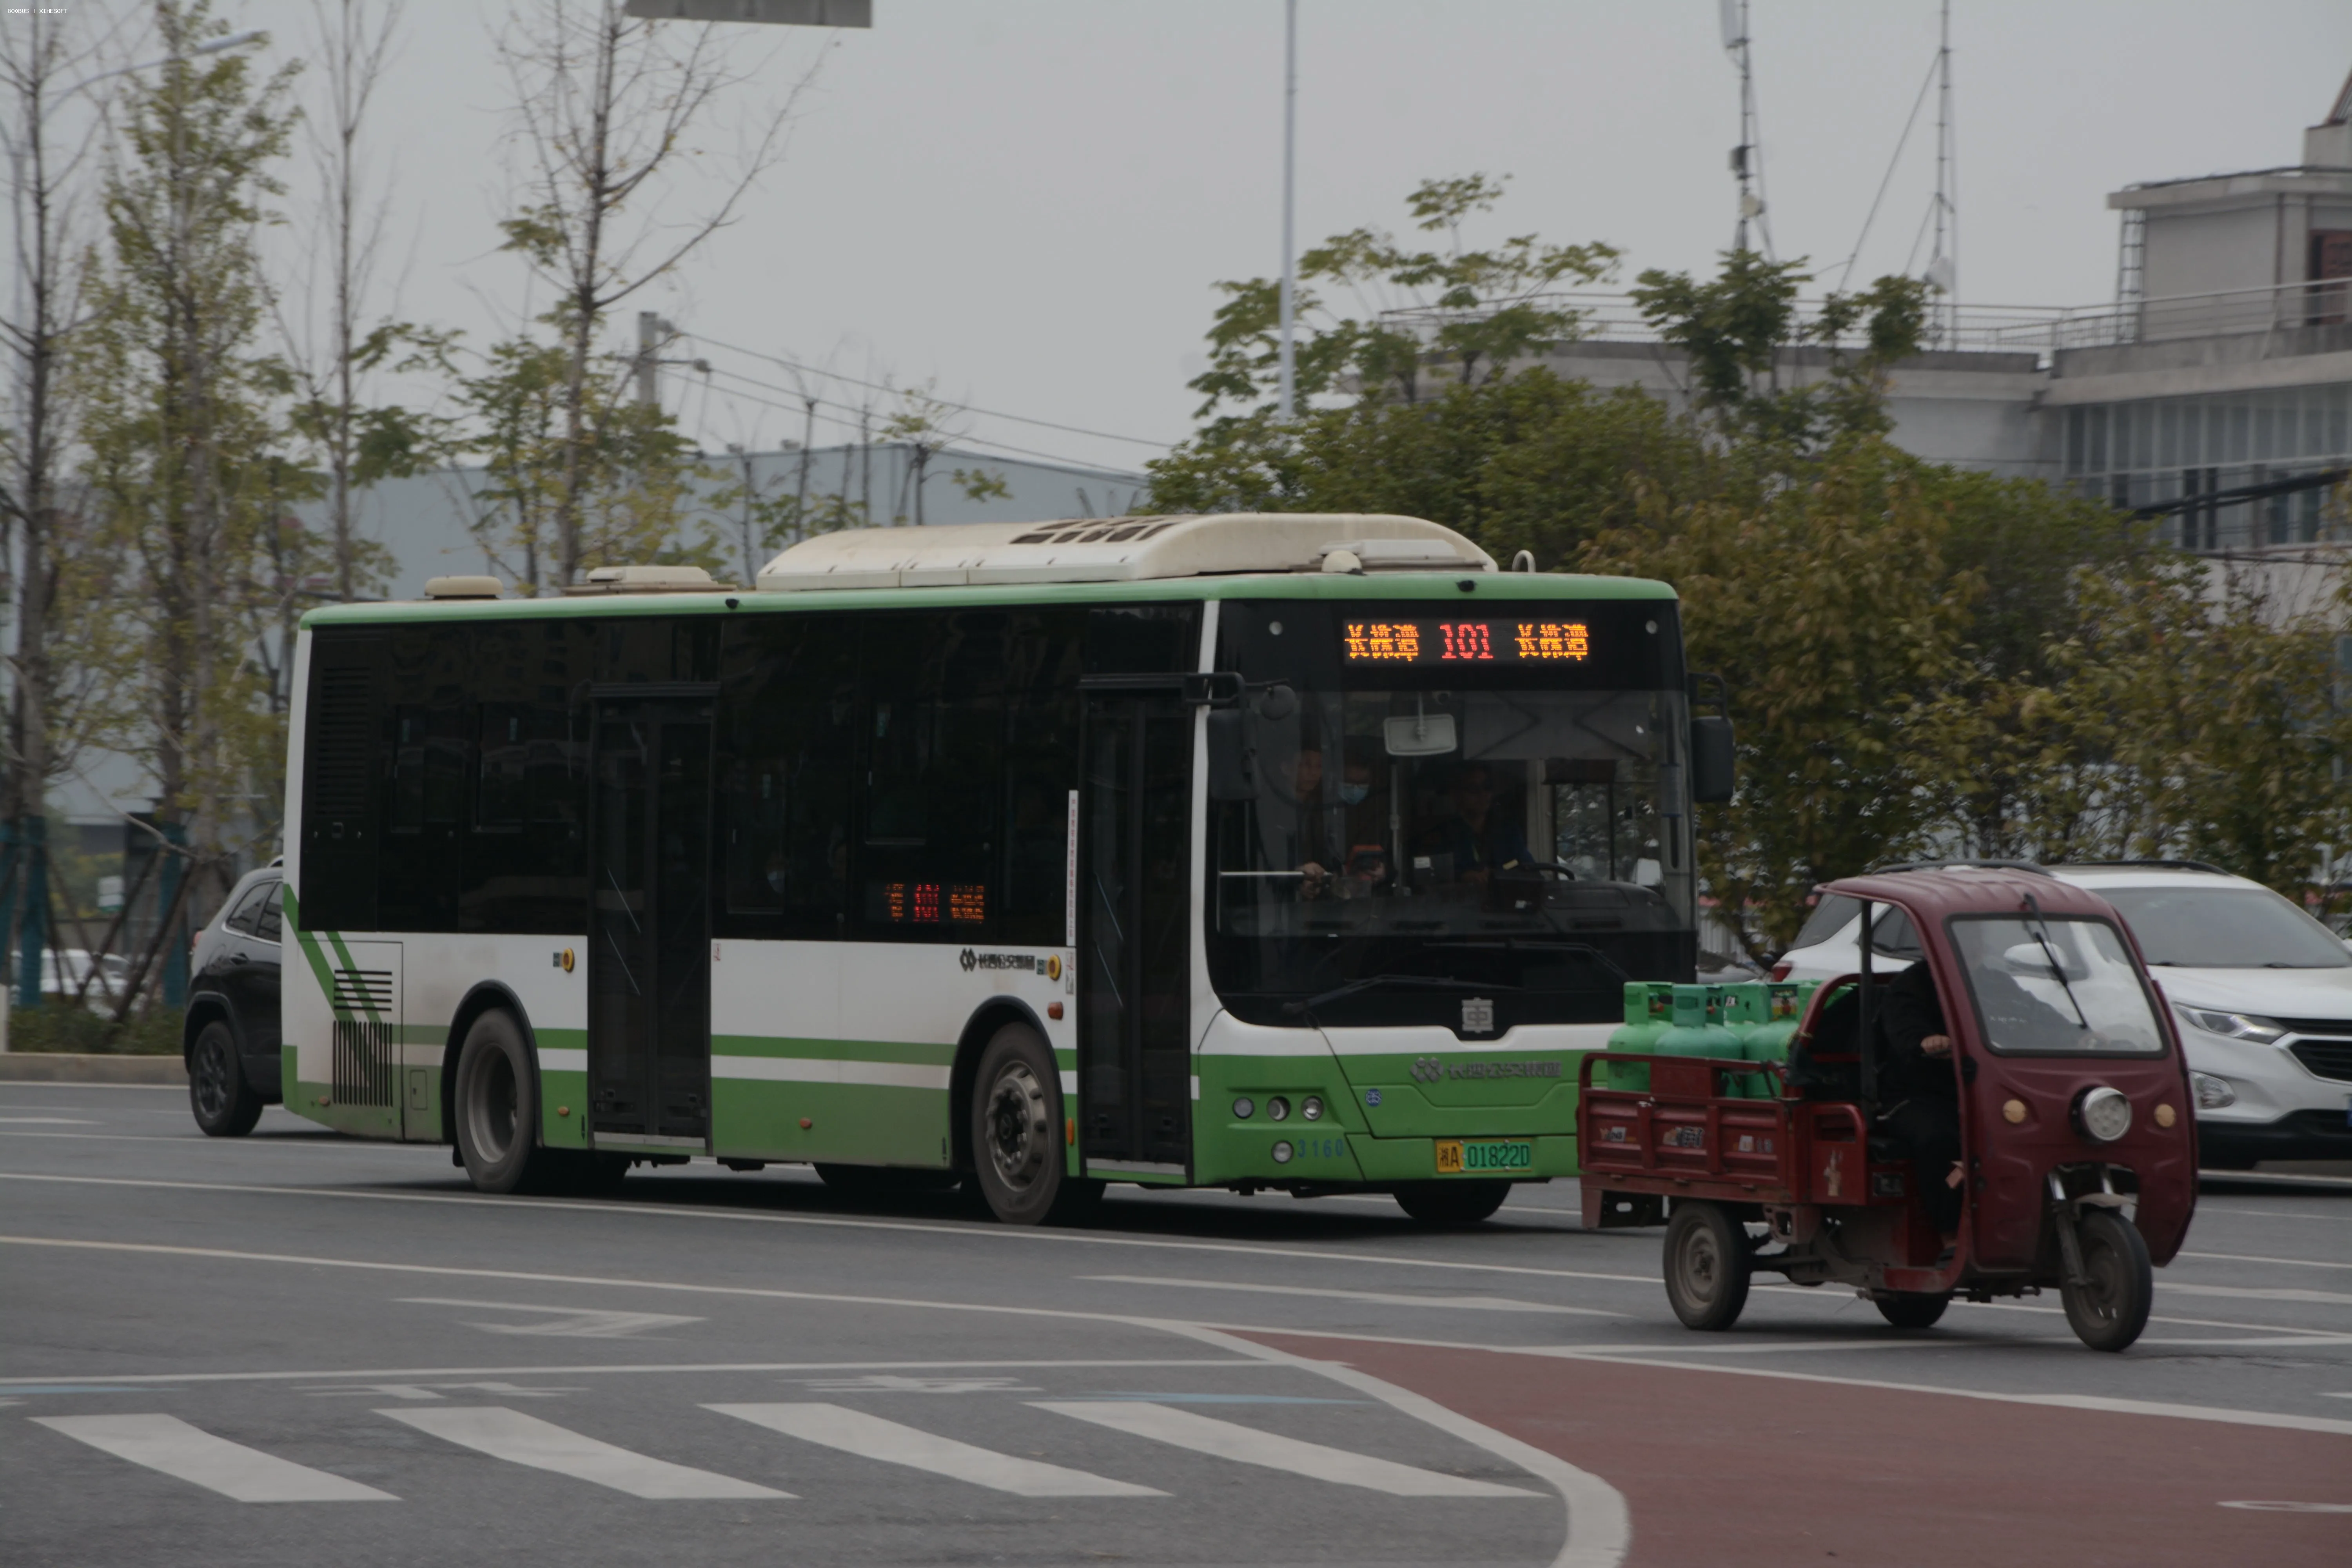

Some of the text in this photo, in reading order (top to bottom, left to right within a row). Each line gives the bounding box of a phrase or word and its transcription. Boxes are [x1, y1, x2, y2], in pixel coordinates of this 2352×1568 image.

[1439, 624, 1494, 659] 101
[1297, 1138, 1343, 1158] 3160
[1468, 1145, 1529, 1167] 01822D
